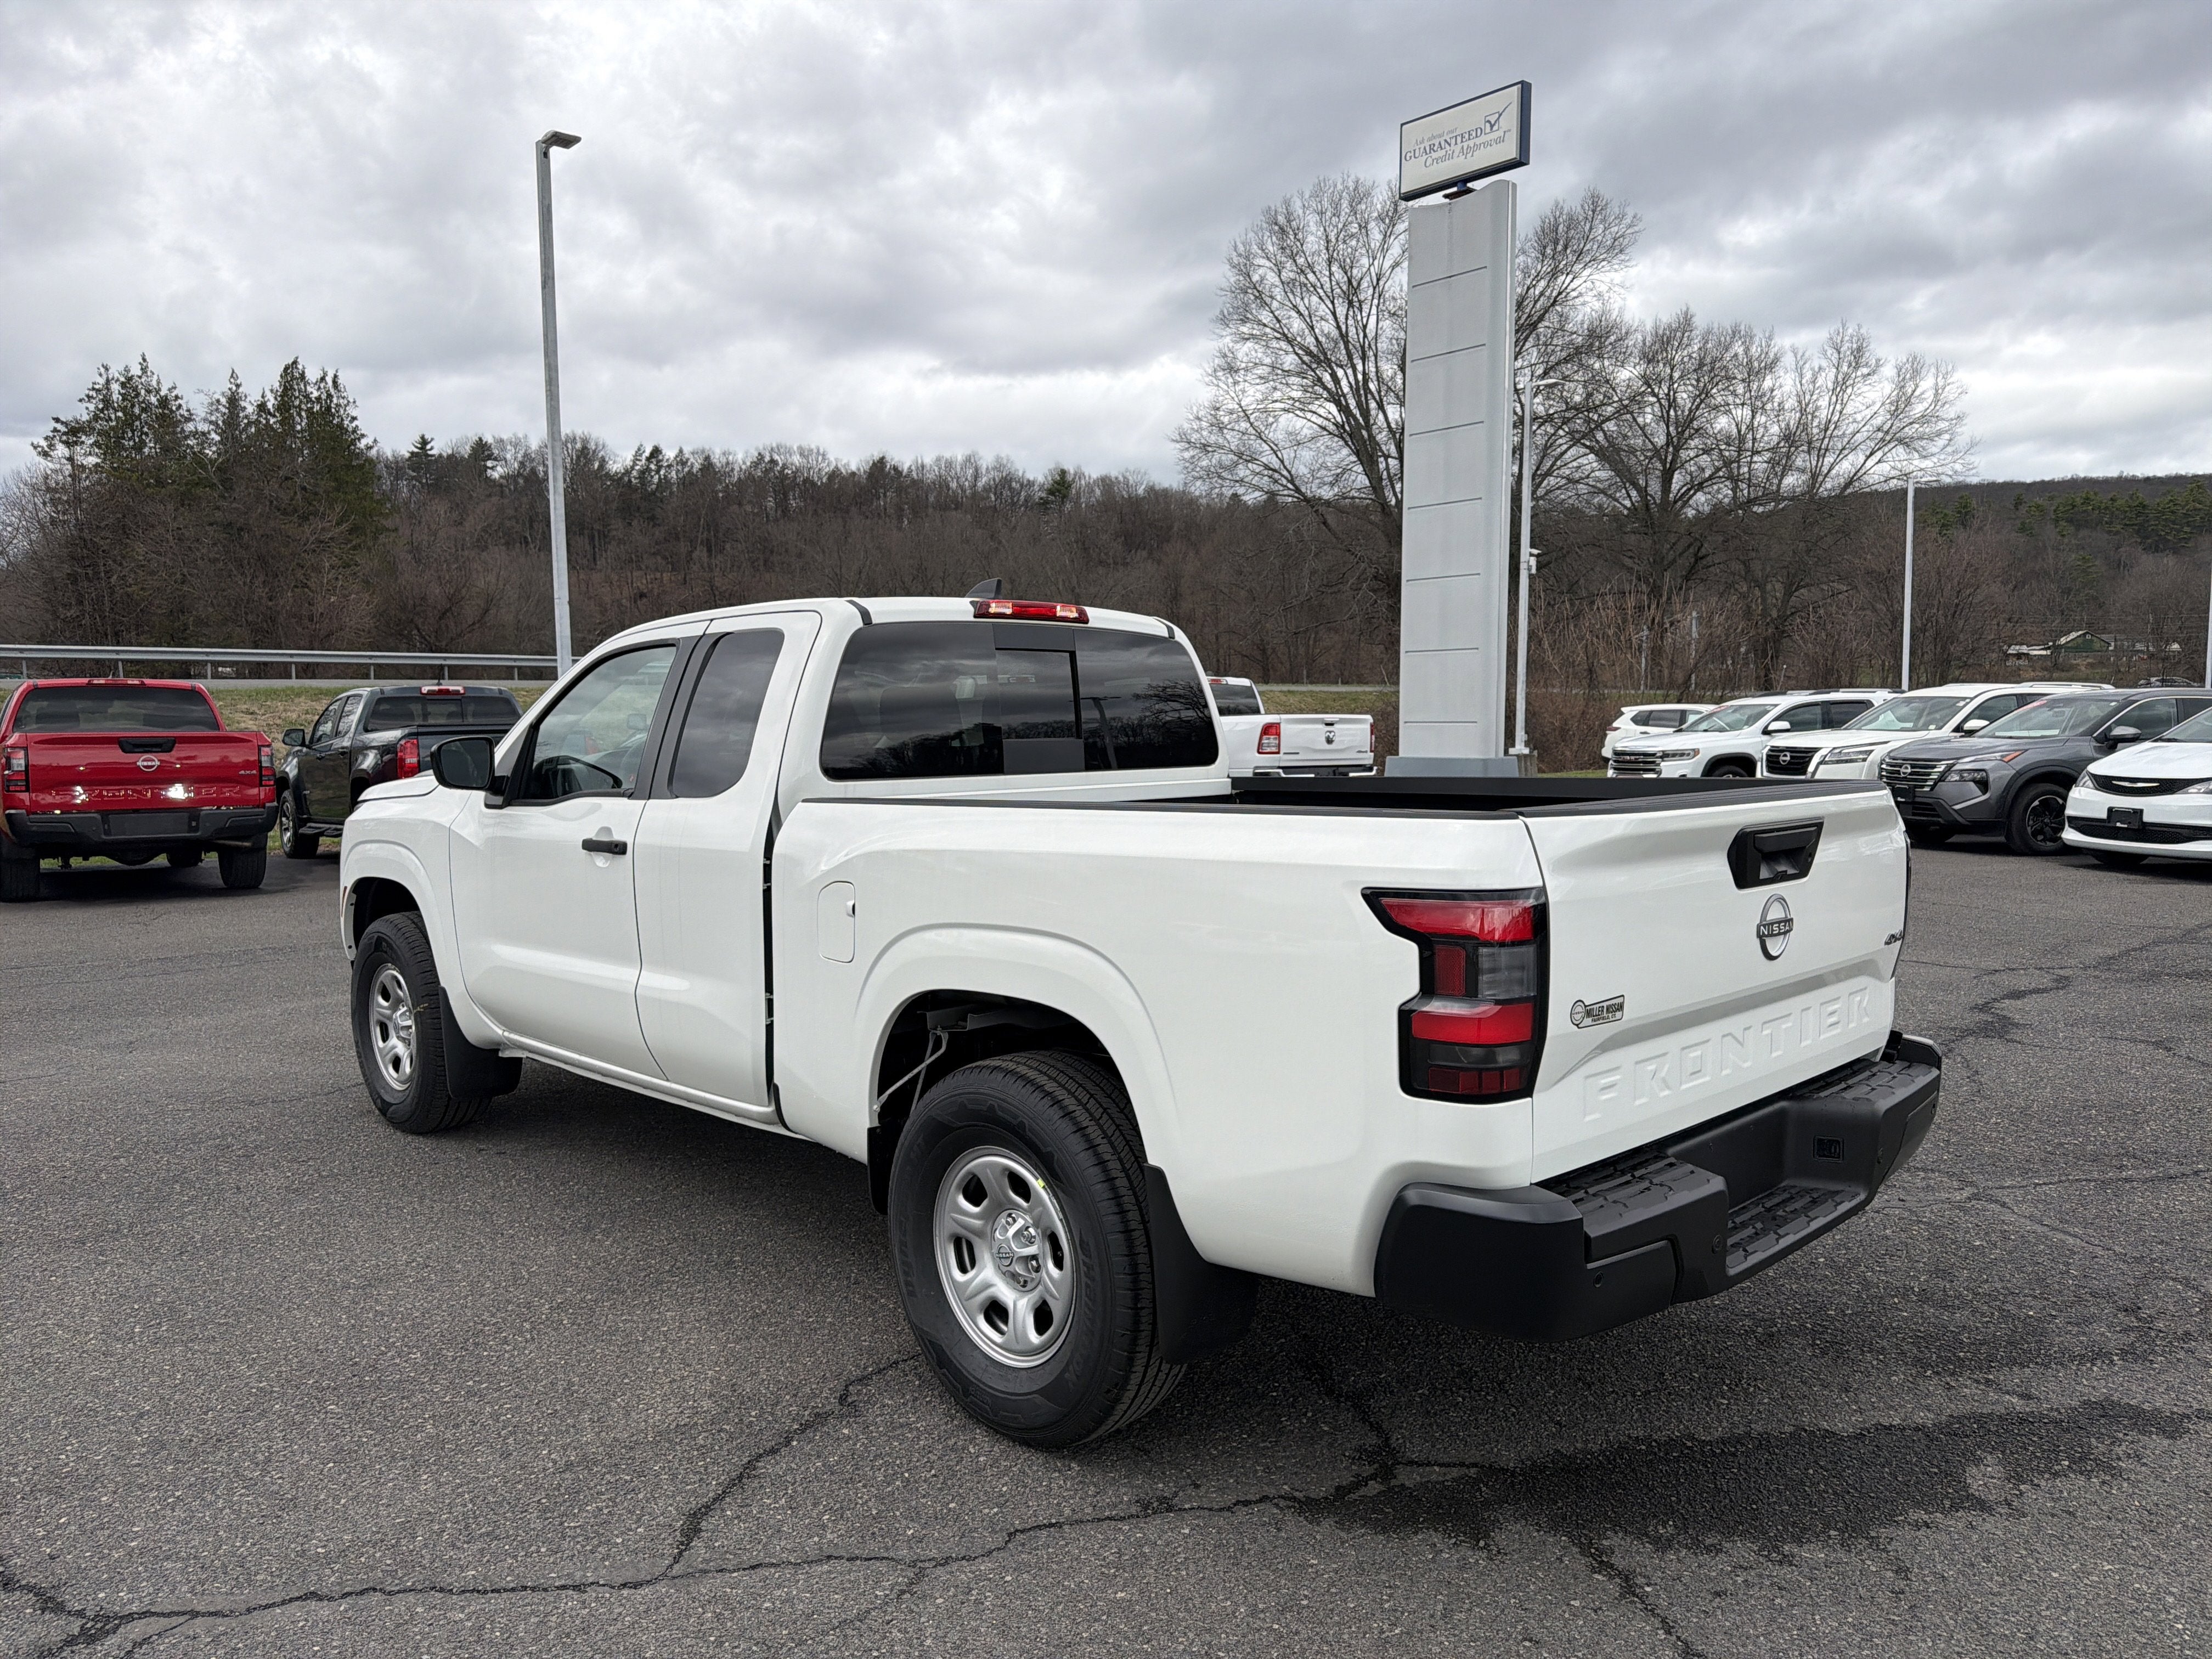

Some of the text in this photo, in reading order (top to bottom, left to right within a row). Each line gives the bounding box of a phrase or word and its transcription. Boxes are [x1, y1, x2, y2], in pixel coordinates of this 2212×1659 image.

[1404, 127, 1483, 162] GUARANTEED
[1426, 130, 1445, 142] about
[1424, 149, 1455, 168] Credit
[1760, 921, 1793, 936] NISSAN
[1586, 1001, 1624, 1019] MILLER NISSAN
[1583, 987, 1870, 1122] FRONTIER
